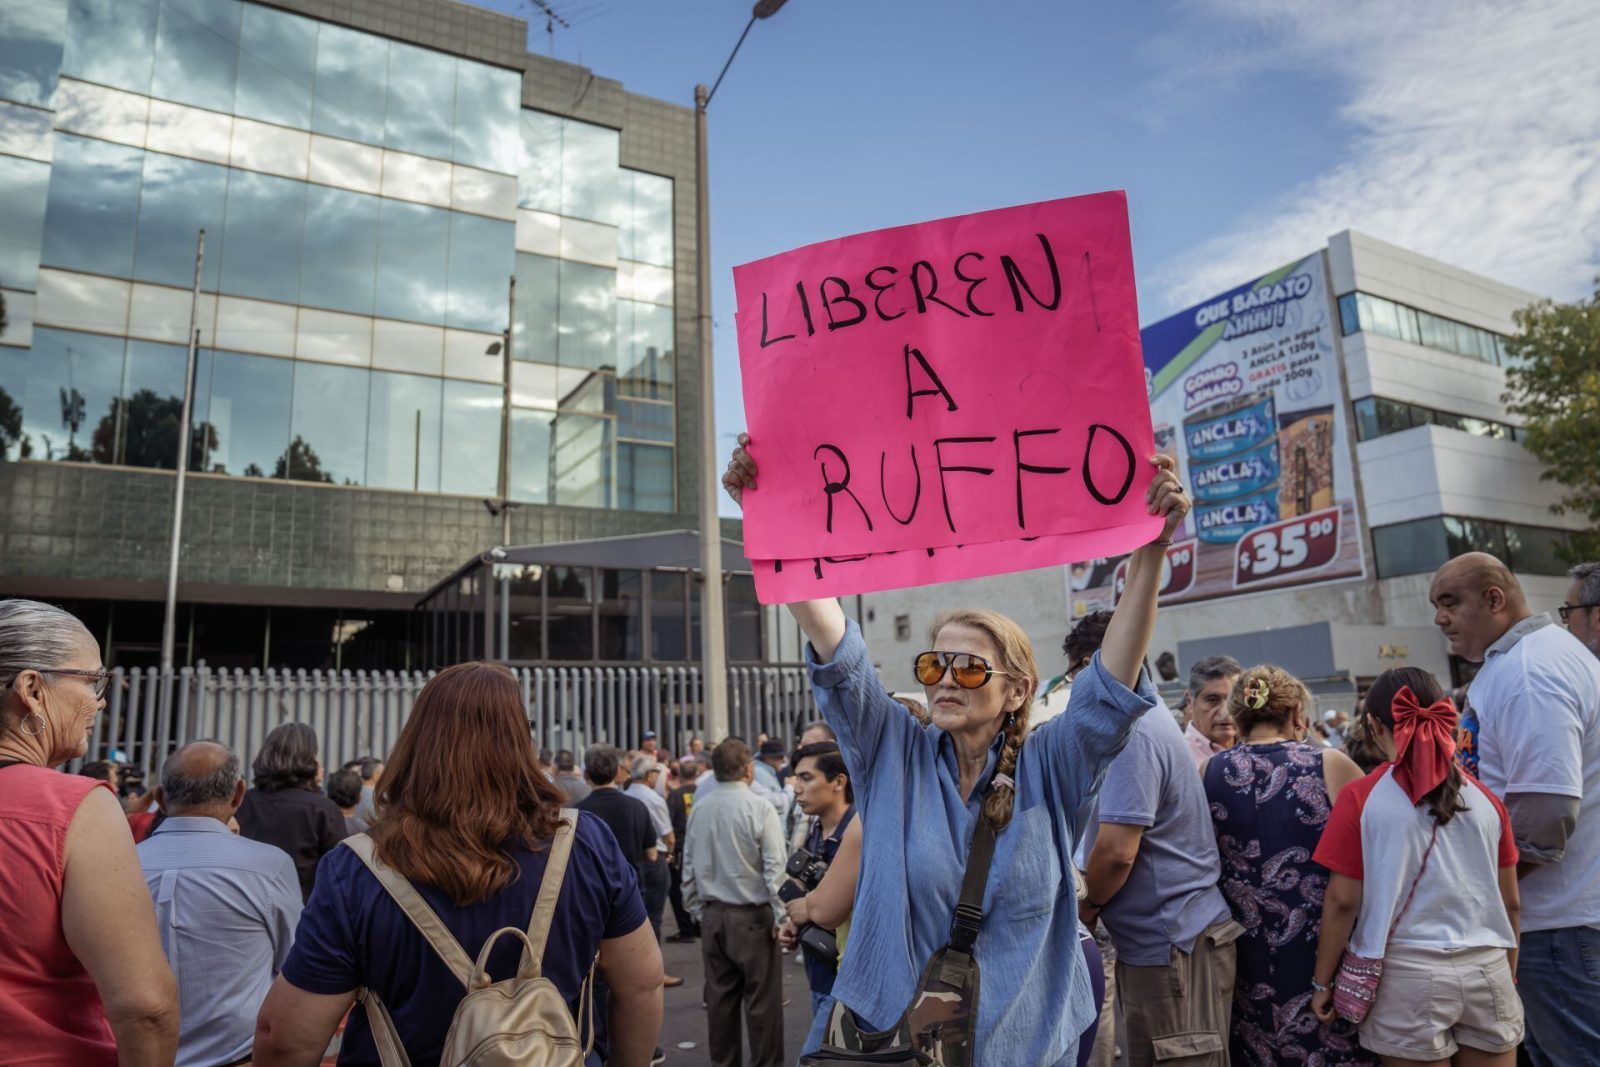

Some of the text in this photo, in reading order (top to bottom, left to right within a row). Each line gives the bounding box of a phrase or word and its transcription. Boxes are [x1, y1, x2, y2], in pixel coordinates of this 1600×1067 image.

[760, 233, 1062, 349] LIBEREN
[1195, 273, 1313, 327] QUE BARATO
[1185, 362, 1238, 393] COMBO
[1248, 353, 1320, 382] GRATIS pasta
[1250, 350, 1286, 369] ANCLA
[1284, 367, 1313, 382] 200g
[904, 344, 959, 420] A
[813, 423, 1136, 534] RUFFO
